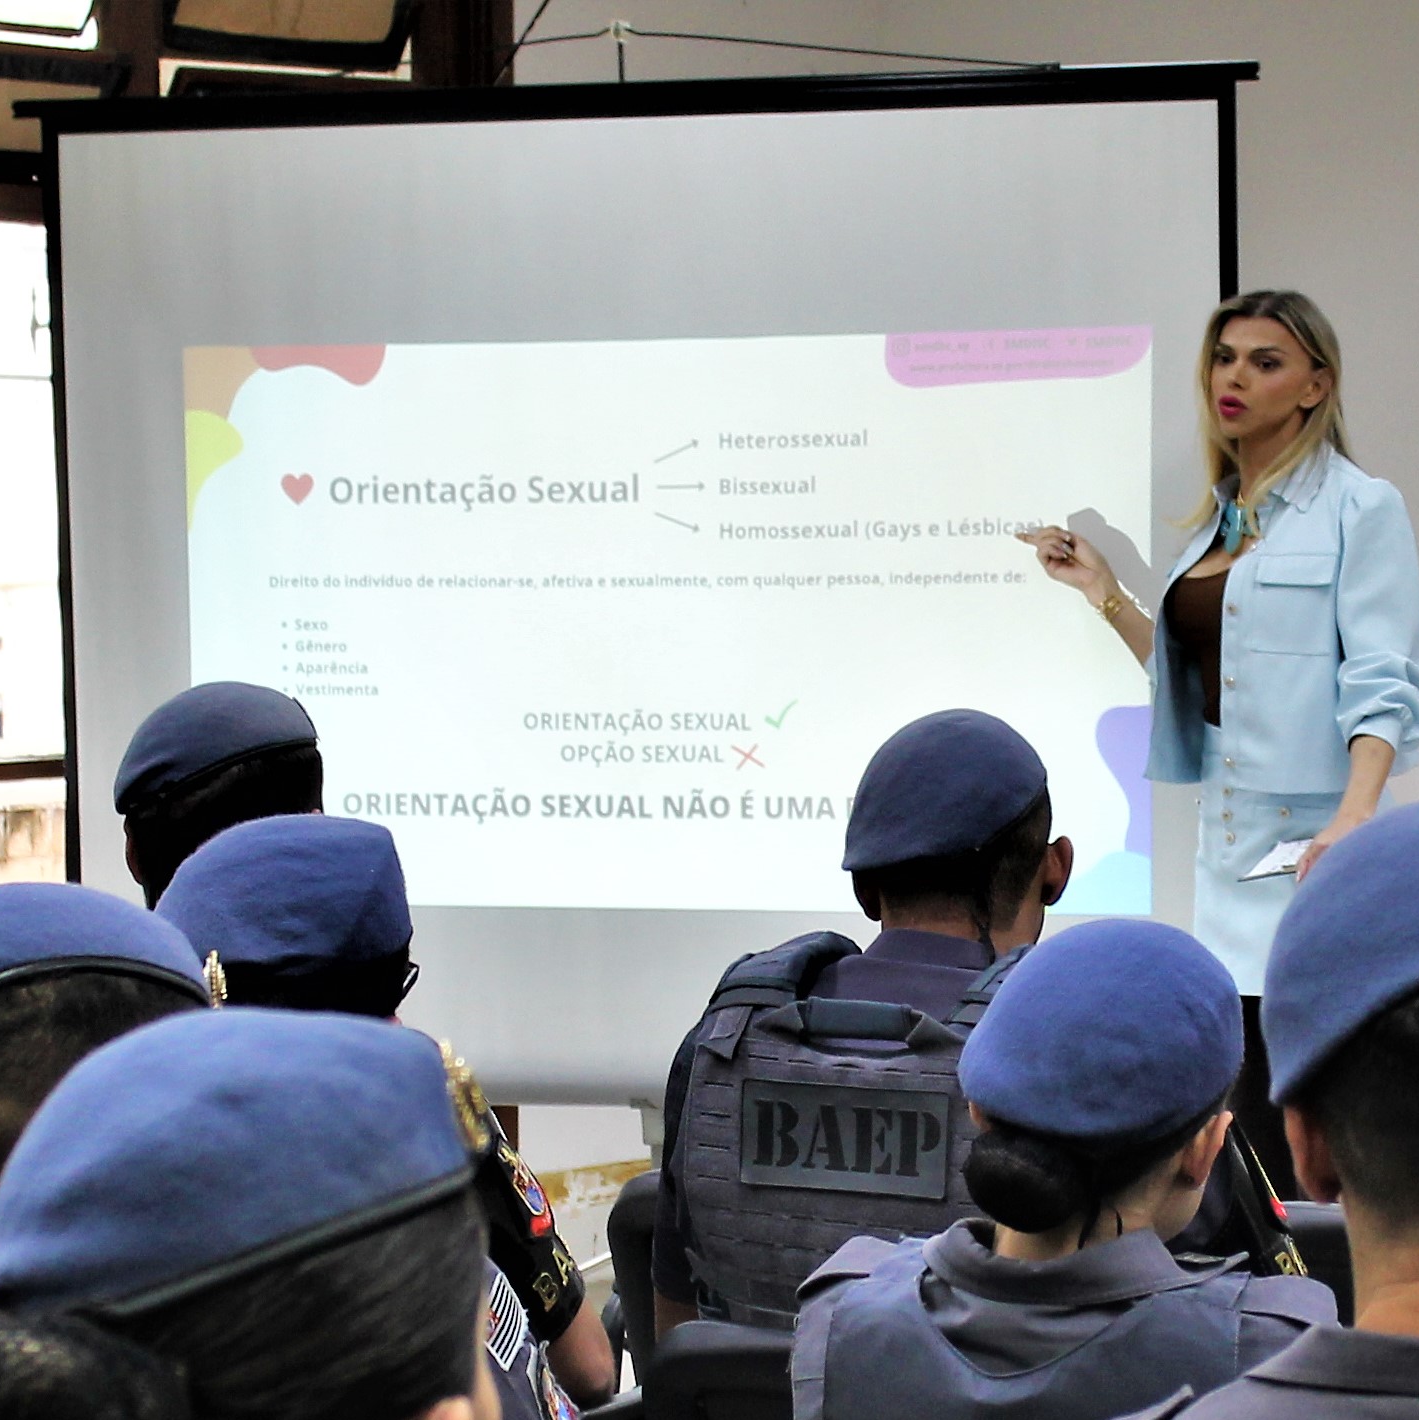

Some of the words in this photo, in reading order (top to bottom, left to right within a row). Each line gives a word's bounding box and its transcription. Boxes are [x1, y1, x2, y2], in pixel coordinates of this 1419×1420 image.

[719, 429, 867, 449] Heterossexual
[329, 475, 517, 511] Orientação
[528, 473, 638, 503] Sexual
[720, 476, 815, 495] Bissexual
[720, 520, 858, 539] Homossexual
[865, 521, 921, 542] (Gays
[928, 524, 939, 536] e
[269, 576, 319, 588] Direito
[323, 575, 341, 587] do
[417, 575, 434, 587] de
[542, 575, 593, 587] afetiva
[598, 578, 606, 587] e
[611, 574, 711, 588] sexualmente,
[717, 576, 748, 586] com
[753, 573, 822, 589] qualquer
[827, 575, 884, 588] pessoa,
[889, 571, 998, 586] independente
[1003, 570, 1026, 583] de:
[295, 619, 328, 630] Sexo
[296, 640, 347, 652] Gênero
[296, 662, 368, 676] Aparência
[296, 683, 379, 697] Vestimenta
[524, 709, 662, 736] ORIENTAÇÃO
[671, 713, 751, 731] SEXUAL
[561, 741, 634, 767] OPÇÃO
[642, 745, 723, 763] SEXUAL
[342, 788, 531, 824] ORIENTAÇÃO
[542, 795, 652, 818] SEXUAL
[663, 789, 730, 818] NÃO
[741, 790, 753, 819] É
[765, 797, 835, 819] UMA
[752, 1099, 942, 1177] BAEP
